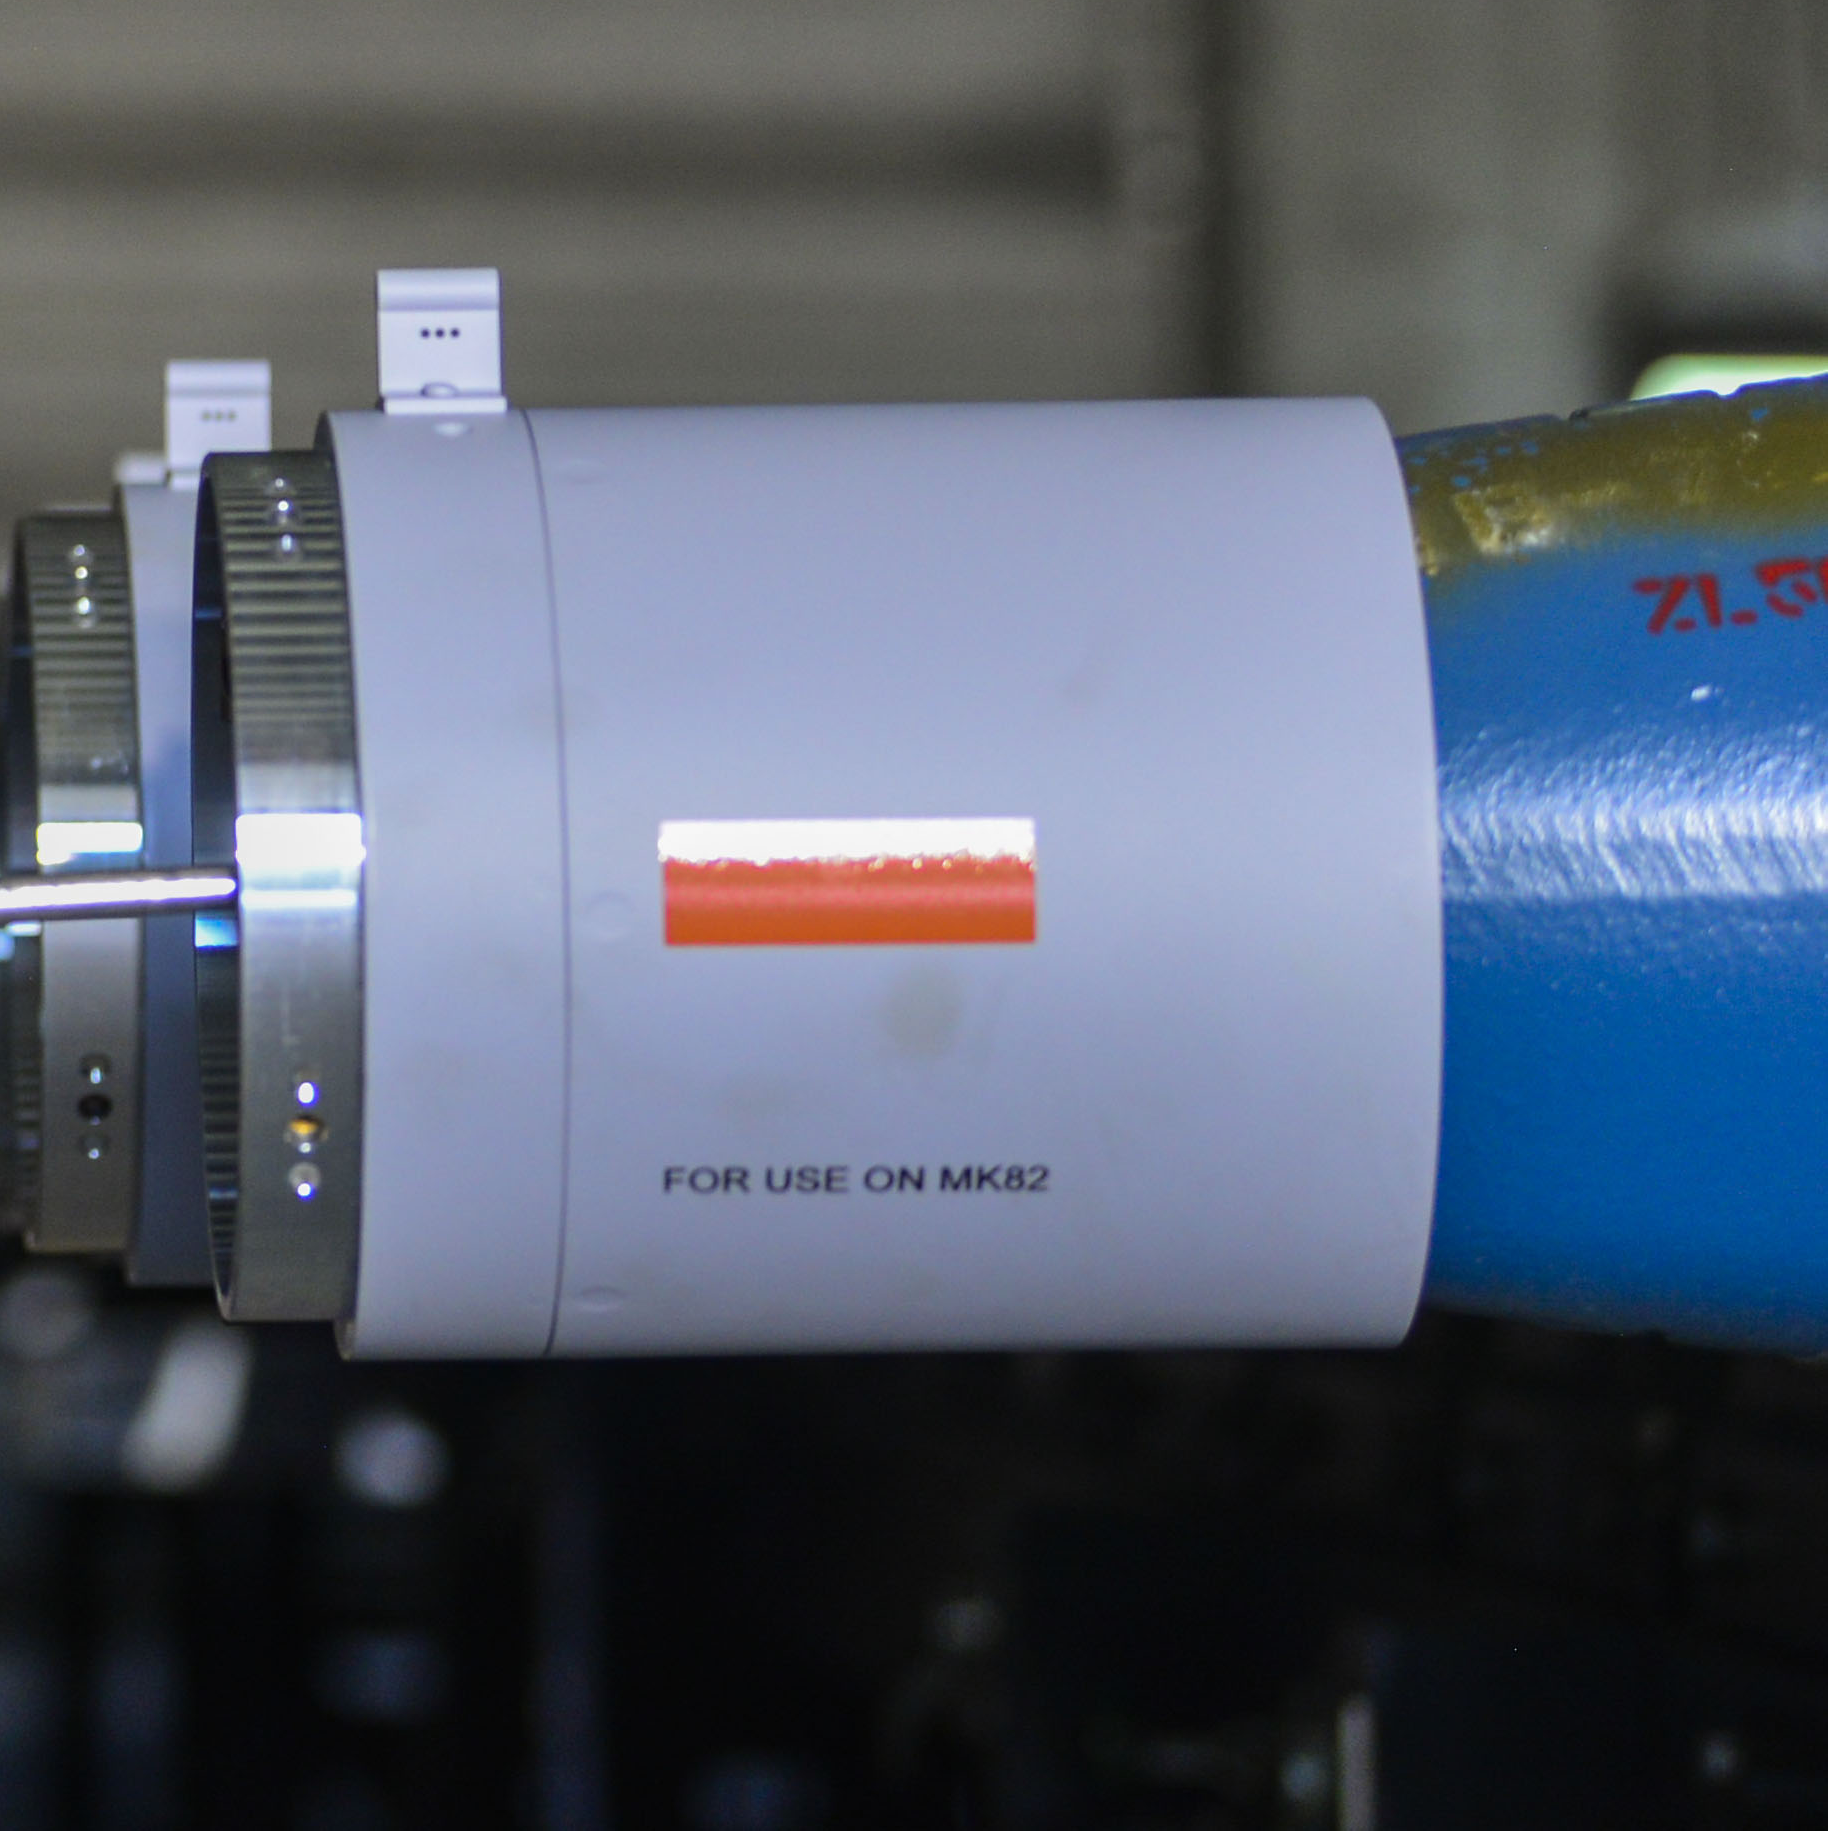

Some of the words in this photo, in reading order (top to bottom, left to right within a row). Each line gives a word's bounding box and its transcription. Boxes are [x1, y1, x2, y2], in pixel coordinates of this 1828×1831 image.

[662, 1165, 750, 1194] FOR
[765, 1165, 850, 1193] USE
[863, 1164, 926, 1193] ON
[939, 1164, 1050, 1192] MK82
